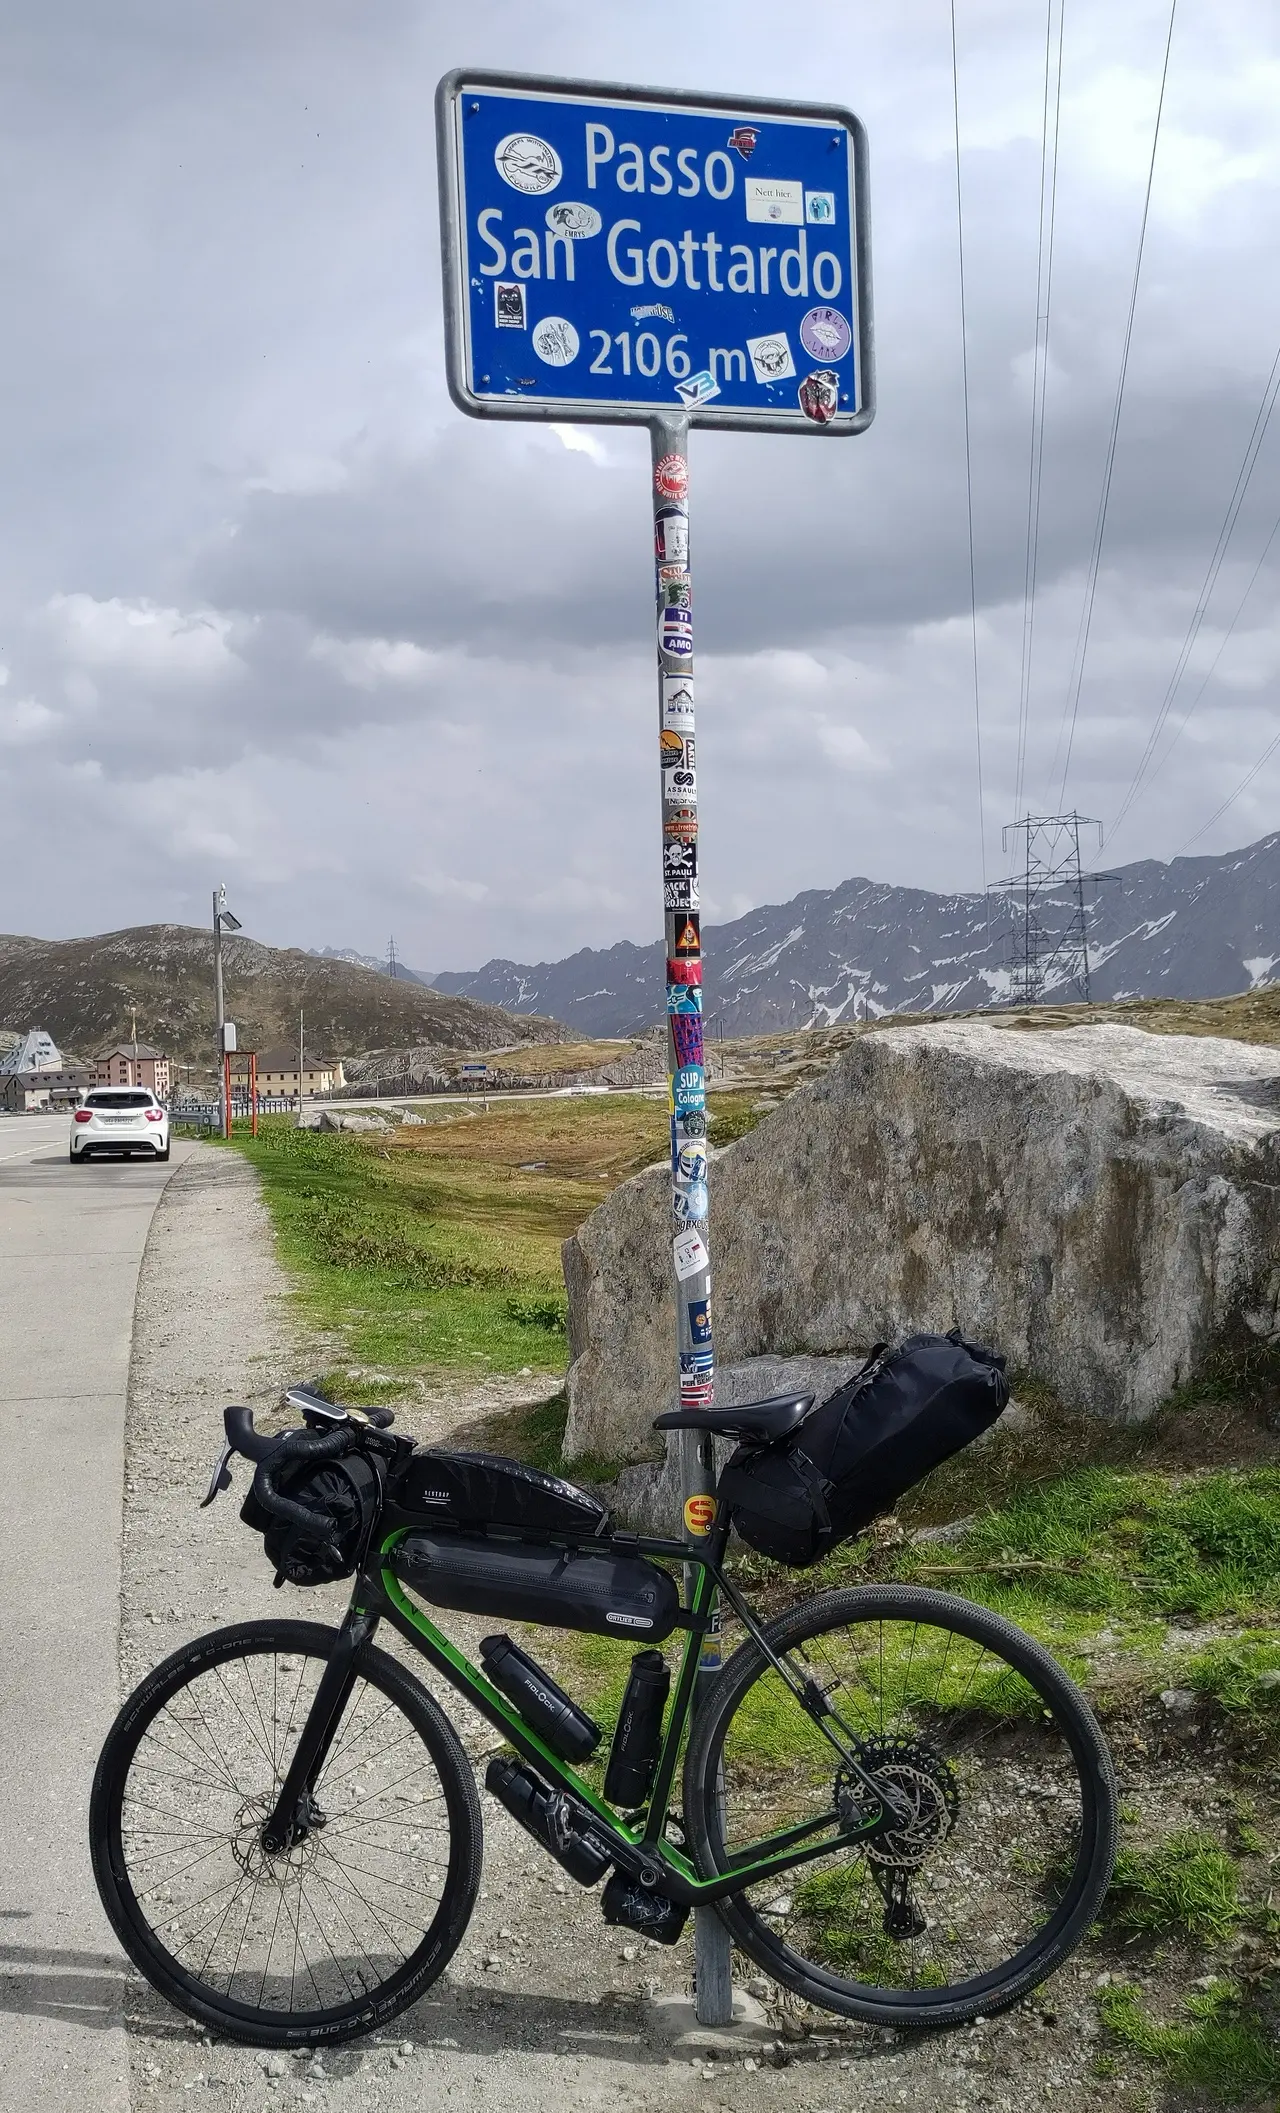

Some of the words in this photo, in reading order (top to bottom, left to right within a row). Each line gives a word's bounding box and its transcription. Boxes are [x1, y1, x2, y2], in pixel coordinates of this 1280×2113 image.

[585, 123, 734, 200] Passo
[755, 187, 773, 197] Nett
[564, 229, 586, 238] EMRYS
[477, 208, 575, 281] San
[606, 219, 842, 299] Gottardo
[588, 329, 691, 379] 2106
[709, 347, 746, 382] m
[678, 612, 688, 621] TI
[668, 639, 691, 650] AMO
[680, 1072, 698, 1088] SUP
[608, 1614, 633, 1623] ORTLIEB
[123, 1663, 186, 1733] SCHWALBE
[524, 1679, 555, 1712] FIDLOCK
[620, 1711, 634, 1752] FIDLOCK
[377, 1941, 442, 2013] SCHWALBE
